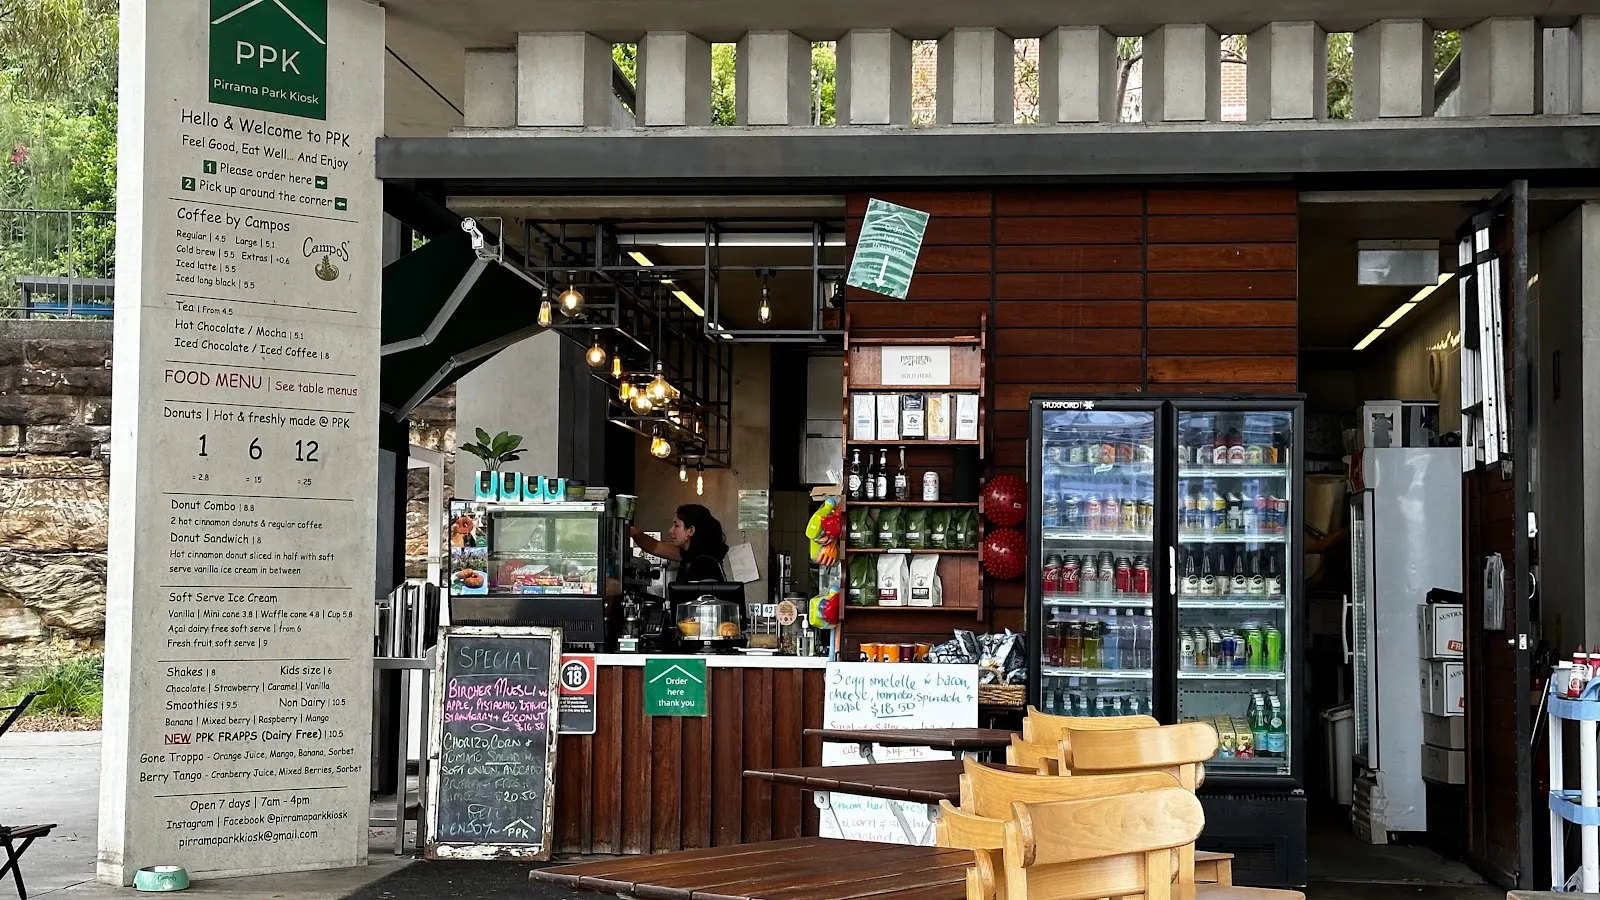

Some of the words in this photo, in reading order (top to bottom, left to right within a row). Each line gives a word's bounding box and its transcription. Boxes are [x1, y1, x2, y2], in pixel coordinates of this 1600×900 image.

[236, 40, 300, 75] PPK
[213, 78, 258, 95] Pirrama
[261, 86, 287, 100] Park
[289, 91, 319, 105] Kiosk
[182, 108, 218, 127] Hello
[224, 116, 233, 130] &
[239, 117, 302, 140] Welcome
[306, 129, 321, 143] to
[326, 130, 350, 147] PPK
[182, 134, 205, 148] Feel
[208, 138, 238, 154] Good,
[242, 143, 260, 156] Eat
[263, 146, 294, 161] Well...
[297, 152, 317, 164] And
[320, 154, 348, 171] Enjoy
[206, 163, 213, 174] 1
[220, 162, 253, 177] Please
[256, 169, 285, 181] order
[289, 172, 312, 185] here
[185, 180, 192, 190] 2
[199, 179, 221, 192] Pick
[224, 185, 236, 197] up
[240, 188, 275, 199] around
[278, 190, 296, 202] the
[299, 195, 332, 206] corner
[177, 207, 222, 224] Coffee
[226, 212, 241, 229] by
[245, 215, 290, 233] Campos
[884, 224, 905, 234] Order
[872, 241, 892, 252] thank
[892, 247, 906, 256] you
[175, 319, 194, 330] Hot
[197, 321, 245, 334] Chocolate
[256, 326, 286, 338] Mocha
[174, 337, 198, 348] Iced
[201, 339, 249, 352] Chocolate
[260, 344, 282, 355] Iced
[285, 347, 318, 358] Coffee
[165, 369, 210, 386] FOOD
[216, 373, 262, 389] MENU
[275, 380, 294, 391] See
[298, 382, 324, 394] table
[327, 387, 357, 396] menus
[164, 406, 202, 419] Donuts
[214, 409, 234, 421] Hot
[237, 411, 244, 422] &
[248, 412, 286, 427] freshly
[289, 415, 316, 426] made
[319, 416, 328, 427] @
[332, 417, 350, 428] PPK
[199, 434, 208, 456] 1
[249, 437, 262, 460] 6
[295, 440, 318, 462] 12
[171, 499, 201, 510] Donut
[204, 500, 236, 511] Combo
[170, 516, 176, 524] 2
[178, 517, 192, 525] hot
[194, 517, 230, 526] cinnamon
[232, 518, 258, 527] donuts
[268, 520, 295, 530] regular
[297, 520, 322, 529] coffee
[170, 532, 200, 542] Donut
[203, 533, 248, 544] Sandwich
[170, 549, 185, 558] Hot
[187, 550, 223, 559] cinnamon
[225, 550, 248, 559] donut
[249, 551, 272, 560] sliced
[283, 552, 298, 560] half
[300, 552, 316, 560] with
[318, 552, 334, 561] soft
[169, 592, 193, 602] Soft
[196, 593, 224, 602] Serve
[227, 592, 244, 602] Ice
[247, 592, 277, 603] Cream
[460, 646, 539, 671] SPECIAL
[167, 666, 203, 677] Shakes
[280, 665, 300, 676] Kids
[302, 665, 321, 674] size
[567, 671, 582, 685] 18
[448, 678, 492, 699] BIRCHER
[494, 678, 536, 697] MUESLI
[832, 669, 842, 685] 3
[846, 676, 864, 693] egg
[166, 699, 218, 710] Smoothies
[226, 701, 237, 709] 9.5
[279, 698, 297, 707] Non
[301, 697, 326, 709] Dairy
[446, 701, 473, 712] APPLE,
[476, 698, 518, 712] PISTACHIO,
[502, 710, 547, 722] COCONUT
[164, 733, 191, 745] NEW
[196, 732, 214, 742] PPK
[218, 731, 258, 743] FRAPPS
[262, 730, 292, 742] (Dairy
[296, 728, 322, 740] Free)
[491, 734, 521, 749] CORN
[442, 750, 482, 763] TOMATO
[488, 751, 520, 762] SALAD
[442, 765, 465, 775] SOFT
[504, 765, 542, 775] AVOCADO
[190, 800, 216, 813] Open
[218, 799, 225, 809] 7
[228, 798, 250, 810] days
[261, 797, 280, 807] 7am
[290, 795, 309, 808] 4pm
[166, 820, 213, 830] Instagram
[223, 814, 264, 826] Facebook
[267, 810, 348, 825] @pirramaparkkiosk
[179, 829, 318, 850] pirramaparkkiosk@gmail.com
[508, 828, 528, 838] PPK
